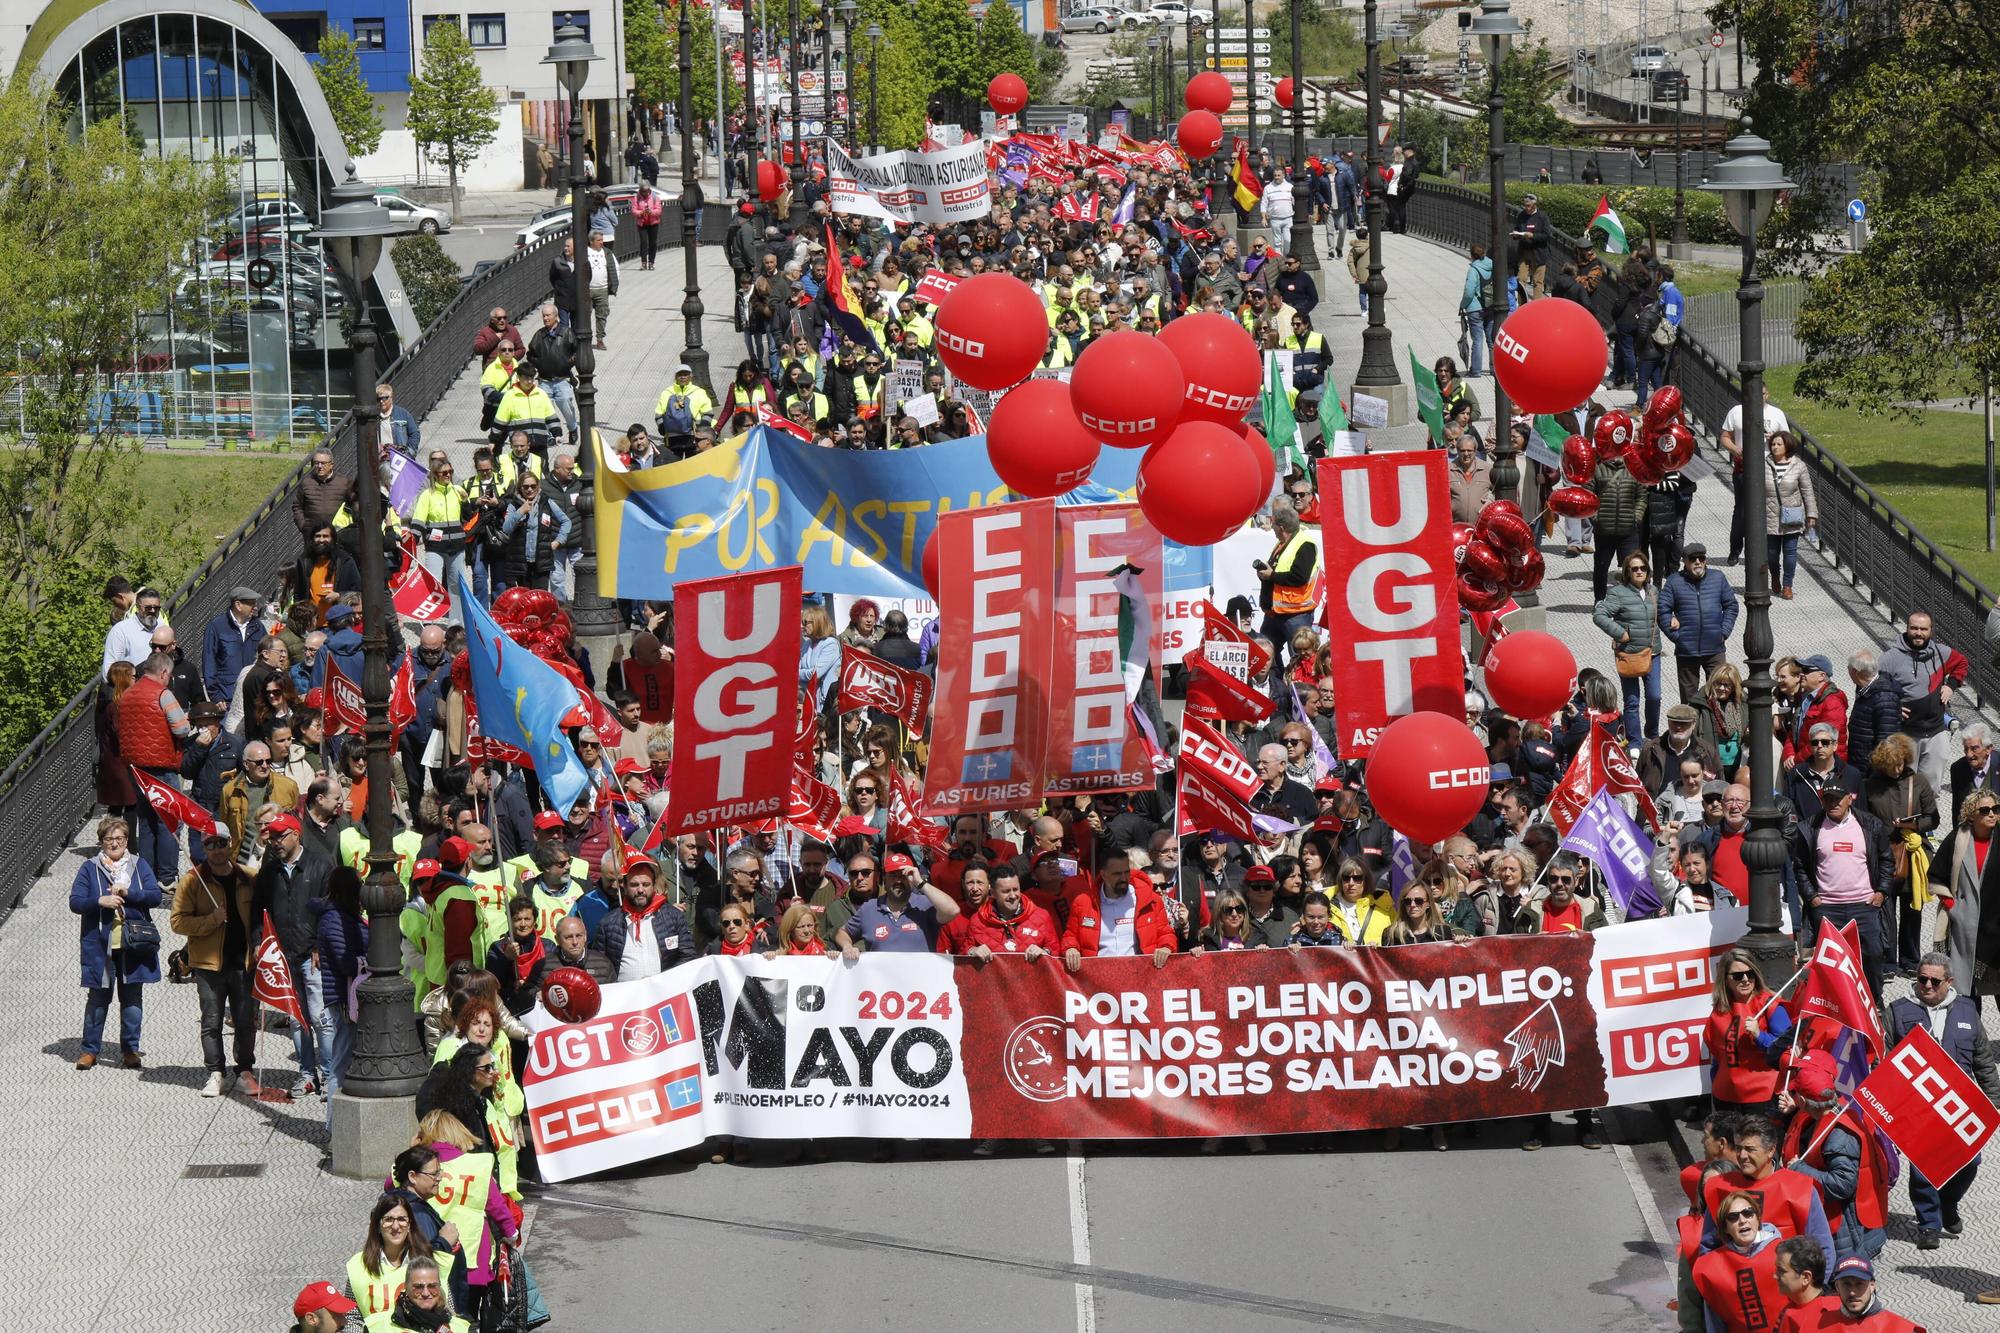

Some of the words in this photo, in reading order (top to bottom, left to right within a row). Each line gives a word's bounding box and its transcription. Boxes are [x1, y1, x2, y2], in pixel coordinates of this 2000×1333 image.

[1578, 51, 1586, 62] S
[944, 188, 979, 203] CCOO
[944, 200, 983, 213] industria
[906, 368, 922, 377] ARCO
[902, 387, 914, 397] YA
[1185, 382, 1257, 411] CCOO
[1082, 412, 1156, 434] CCOO
[663, 478, 780, 574] POR
[1455, 547, 1467, 561] UGT
[1340, 464, 1438, 717] UGT
[965, 512, 1022, 751] CCOO
[1073, 517, 1128, 743] CCOO
[1209, 650, 1220, 662] EL
[1222, 651, 1247, 663] ARCO
[1239, 667, 1246, 678] 8
[693, 581, 782, 801] UGT
[848, 662, 899, 700] UGT
[909, 679, 922, 728] www.ugt.es
[1182, 729, 1258, 787] CCOO
[932, 781, 1032, 806] ASTURIES
[1043, 771, 1144, 793] ASTURIES
[1429, 766, 1490, 791] CCOO
[681, 796, 781, 829] ASTURIAS
[1182, 771, 1249, 836] CCOO
[554, 986, 567, 1005] UGT
[1065, 990, 1151, 1025] POR
[1162, 988, 1217, 1022] EL
[1228, 981, 1372, 1020] PLENO
[1384, 966, 1574, 1013] EMPLEO:
[1817, 937, 1881, 1036] CCOO
[857, 990, 953, 1020] 2024
[528, 1022, 614, 1077] UGT
[1066, 1025, 1223, 1061] MENOS
[1234, 1016, 1459, 1058] JORNADA,
[1624, 1023, 1710, 1071] UGT
[1066, 1060, 1273, 1099] MEJORES
[1285, 1049, 1503, 1093] SALARIOS
[714, 1092, 825, 1108] #PLENOEMPLEO
[829, 1092, 838, 1108] /
[842, 1093, 950, 1108] #1MAYO2024
[1859, 1086, 1894, 1124] ASTURIAS
[1891, 1043, 1987, 1147] CCOO
[539, 1089, 662, 1145] CCOO
[435, 1172, 475, 1206] GT
